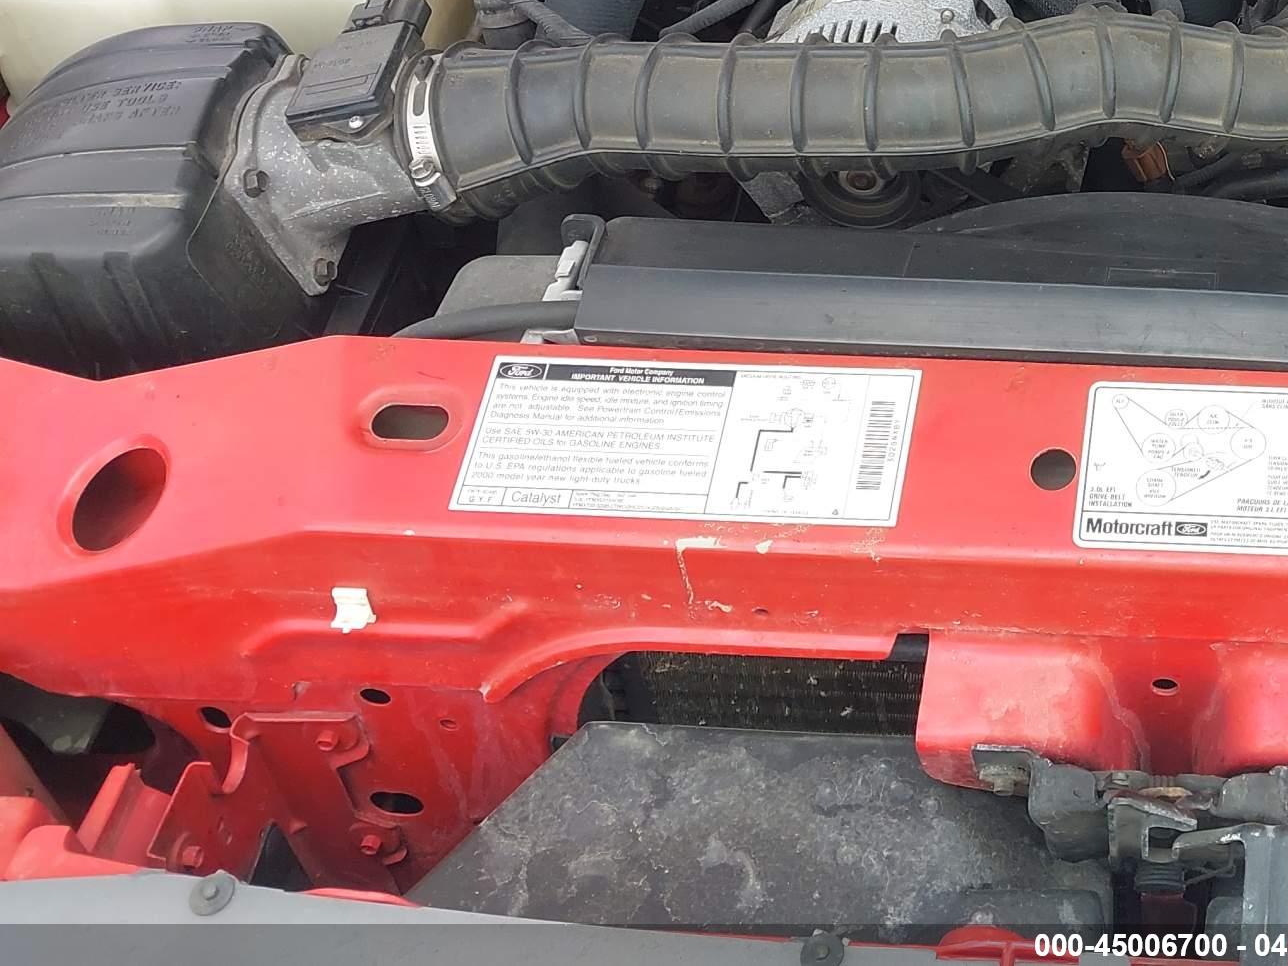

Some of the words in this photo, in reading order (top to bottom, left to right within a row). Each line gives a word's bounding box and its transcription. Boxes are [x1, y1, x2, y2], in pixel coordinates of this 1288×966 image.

[572, 373, 616, 382] IMPORTANT
[618, 375, 651, 383] VEHICLE
[652, 376, 705, 384] INFORMATION
[485, 427, 501, 435] Use
[555, 429, 604, 438] AMERICAN
[607, 432, 664, 440] PETROLEUM
[667, 433, 714, 442] INSTITUTE
[482, 436, 530, 445] CERTIFIED
[533, 438, 554, 446] OILS
[569, 439, 616, 448] GASOLINE
[511, 490, 561, 504] Catalyst
[1086, 517, 1172, 536] Motorcraft
